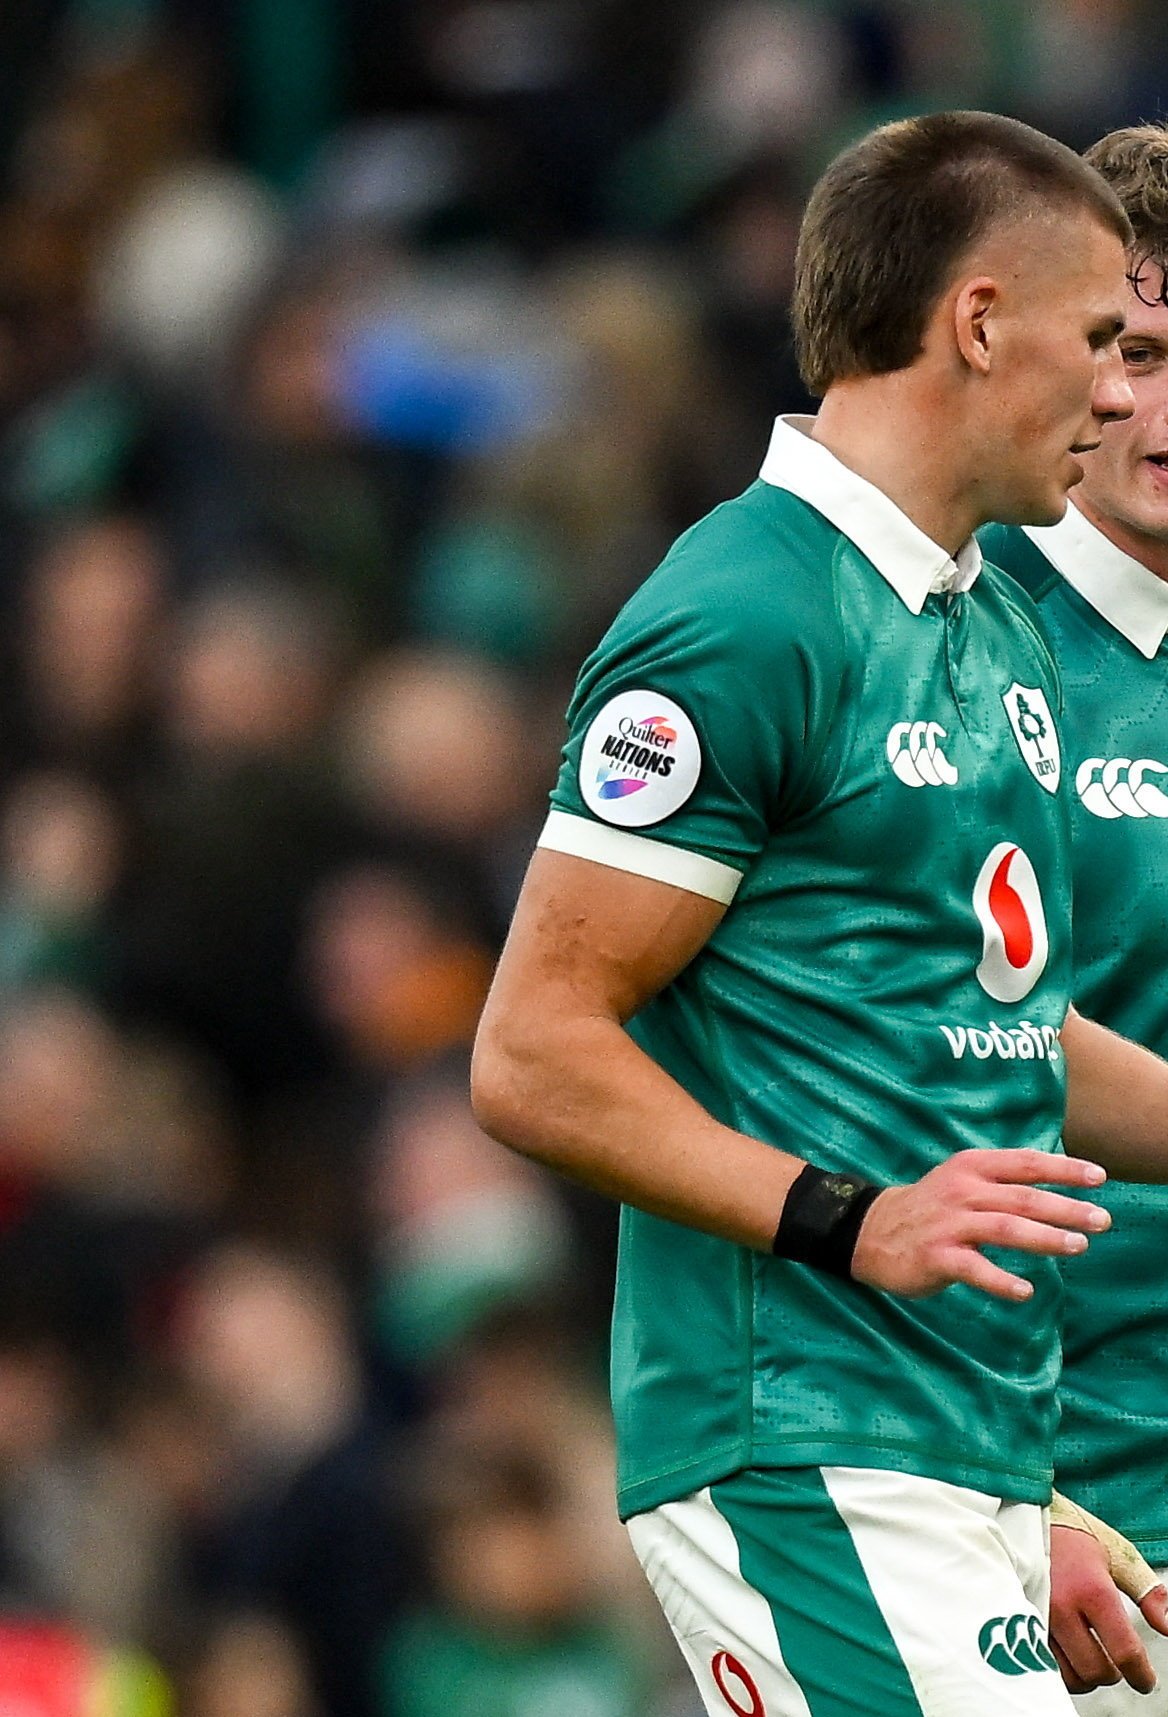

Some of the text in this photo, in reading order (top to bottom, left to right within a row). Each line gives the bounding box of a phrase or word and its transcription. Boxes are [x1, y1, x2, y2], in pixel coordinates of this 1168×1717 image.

[618, 716, 674, 750] Quilter
[600, 734, 676, 777] NATIONS
[938, 1020, 1060, 1060] vodafo
